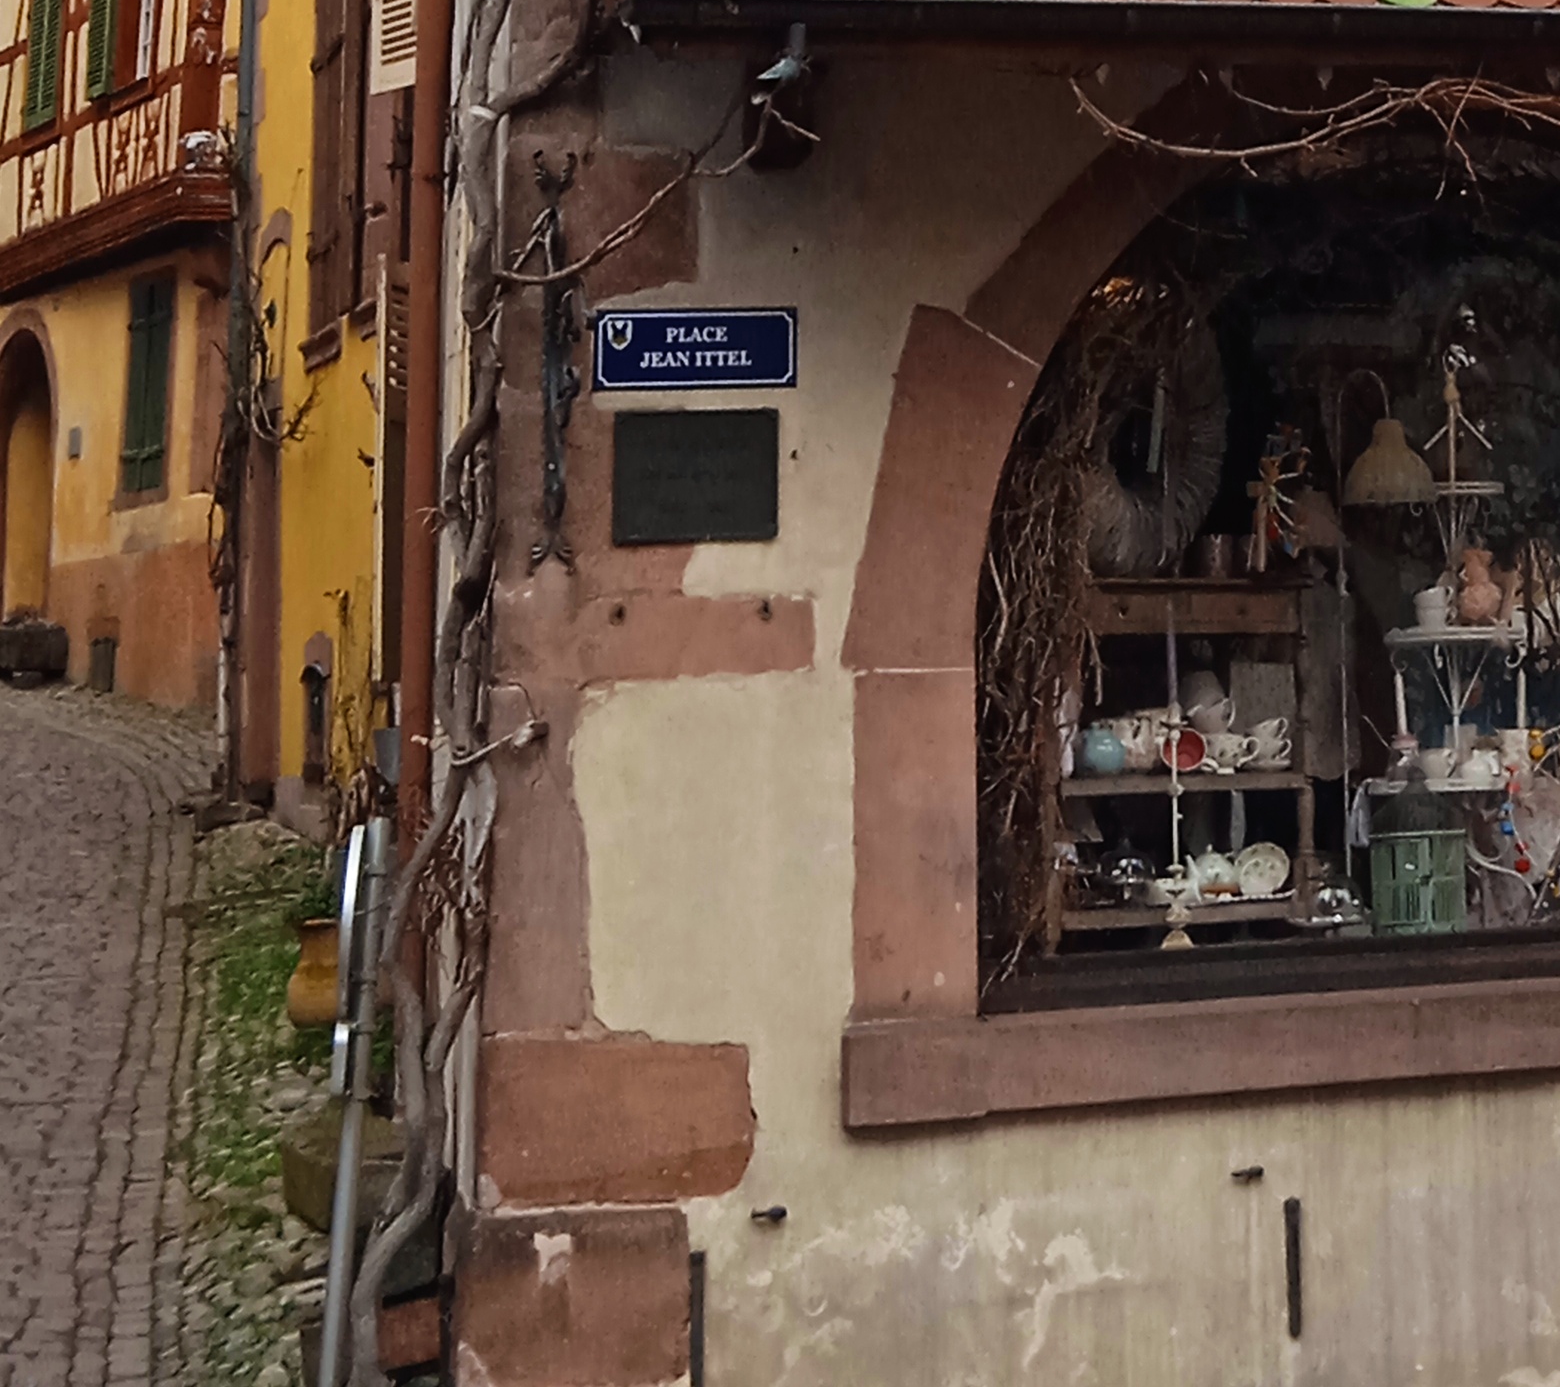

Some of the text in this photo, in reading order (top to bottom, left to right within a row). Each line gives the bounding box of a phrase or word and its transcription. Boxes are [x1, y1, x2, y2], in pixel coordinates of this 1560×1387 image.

[665, 327, 728, 343] PLACE
[639, 350, 752, 369] JEAN ITTEL
